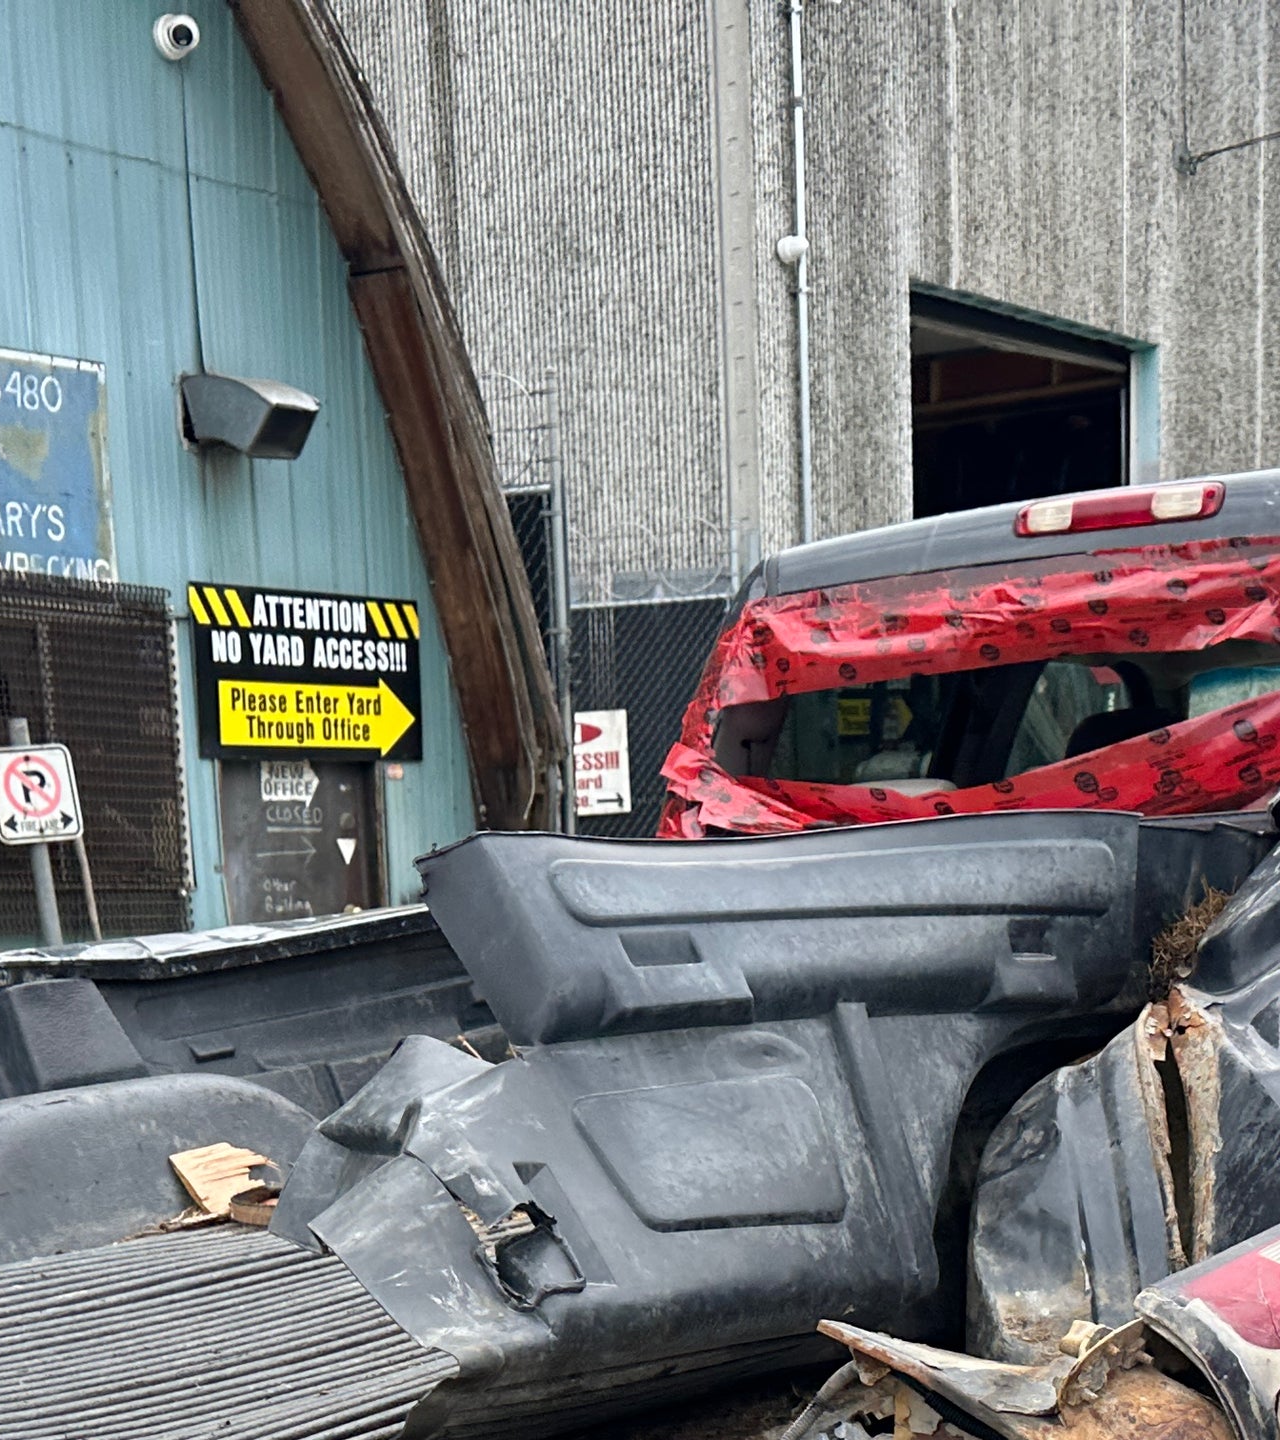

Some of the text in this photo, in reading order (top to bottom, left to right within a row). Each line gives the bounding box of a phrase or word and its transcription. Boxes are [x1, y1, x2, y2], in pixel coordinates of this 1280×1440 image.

[252, 594, 367, 634] ATTENTION
[211, 630, 408, 672] NO YARD ACCESS!!!
[231, 687, 382, 716] Please Enter Yard
[246, 715, 370, 744] Through Office
[263, 778, 313, 796] OFFICE
